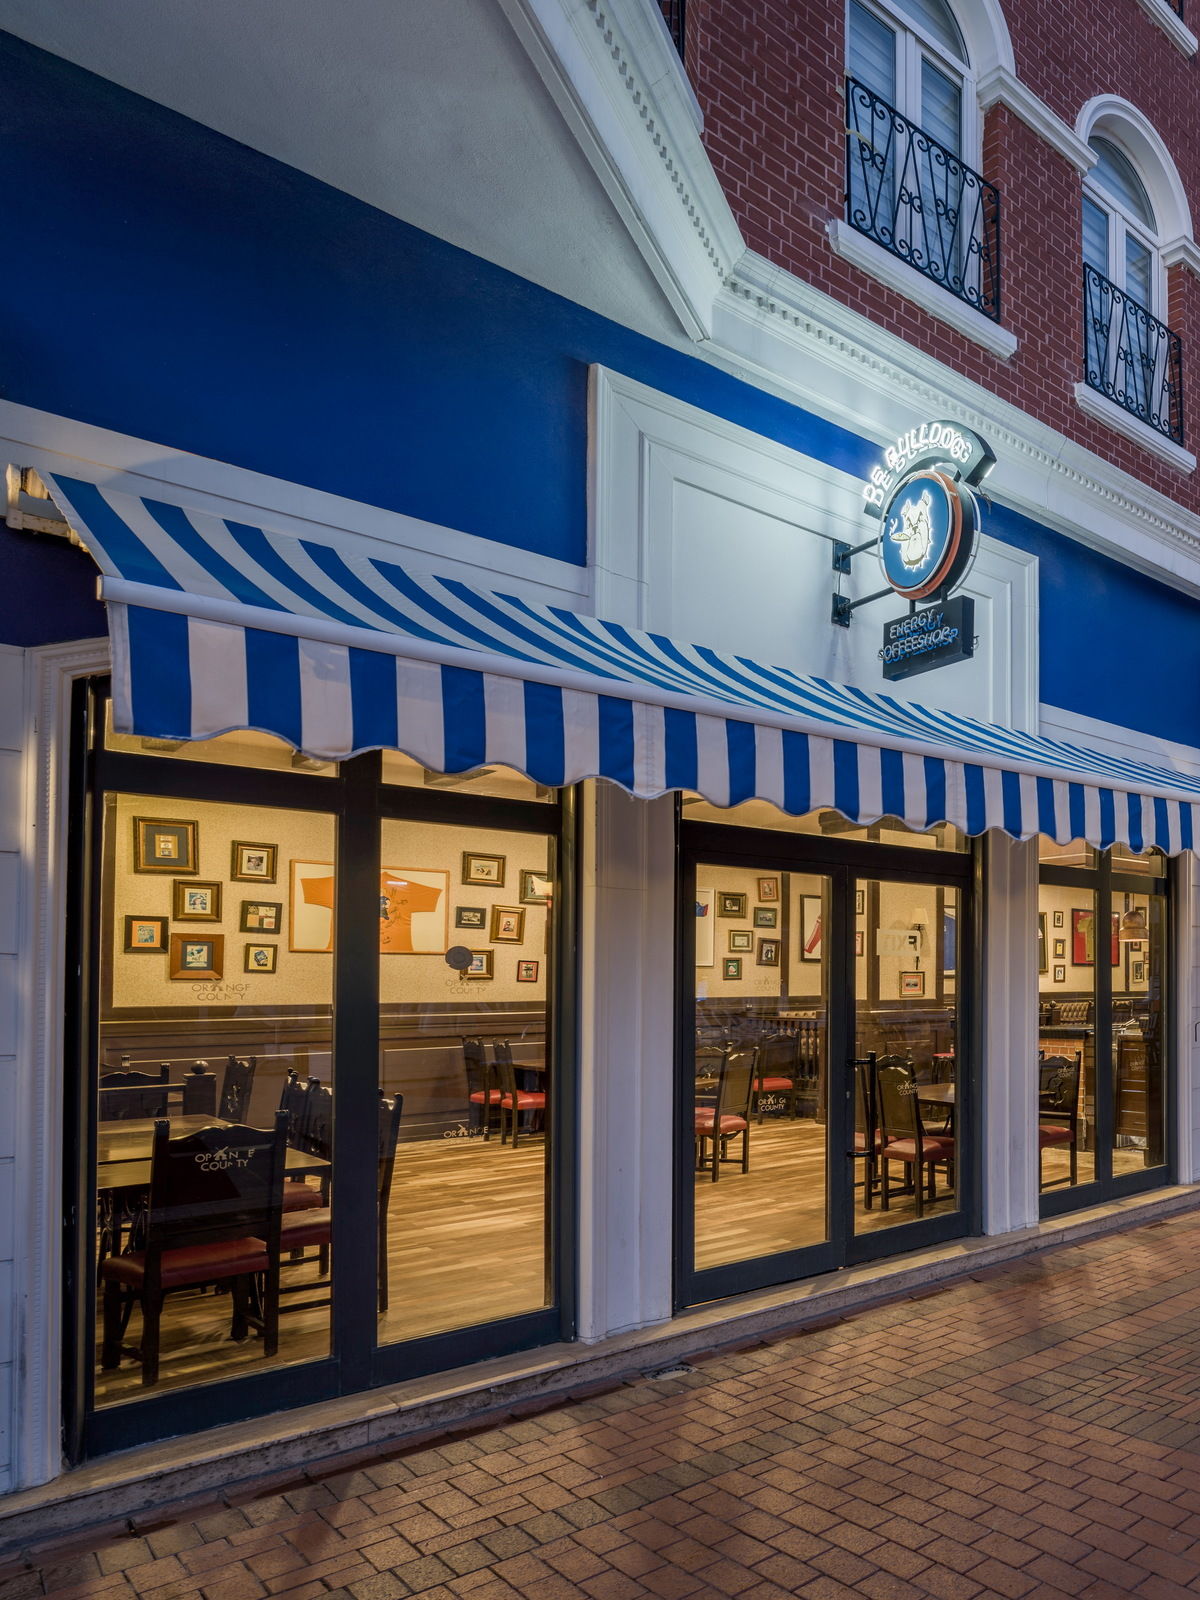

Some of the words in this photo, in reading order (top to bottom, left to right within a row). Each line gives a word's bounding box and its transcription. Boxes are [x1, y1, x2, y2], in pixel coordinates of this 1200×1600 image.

[889, 609, 943, 640] ENERGY
[878, 626, 958, 663] COFFEESHOP
[192, 980, 251, 992] ORANGE
[761, 1103, 785, 1111] COUNTY
[195, 1147, 256, 1162] ORANE
